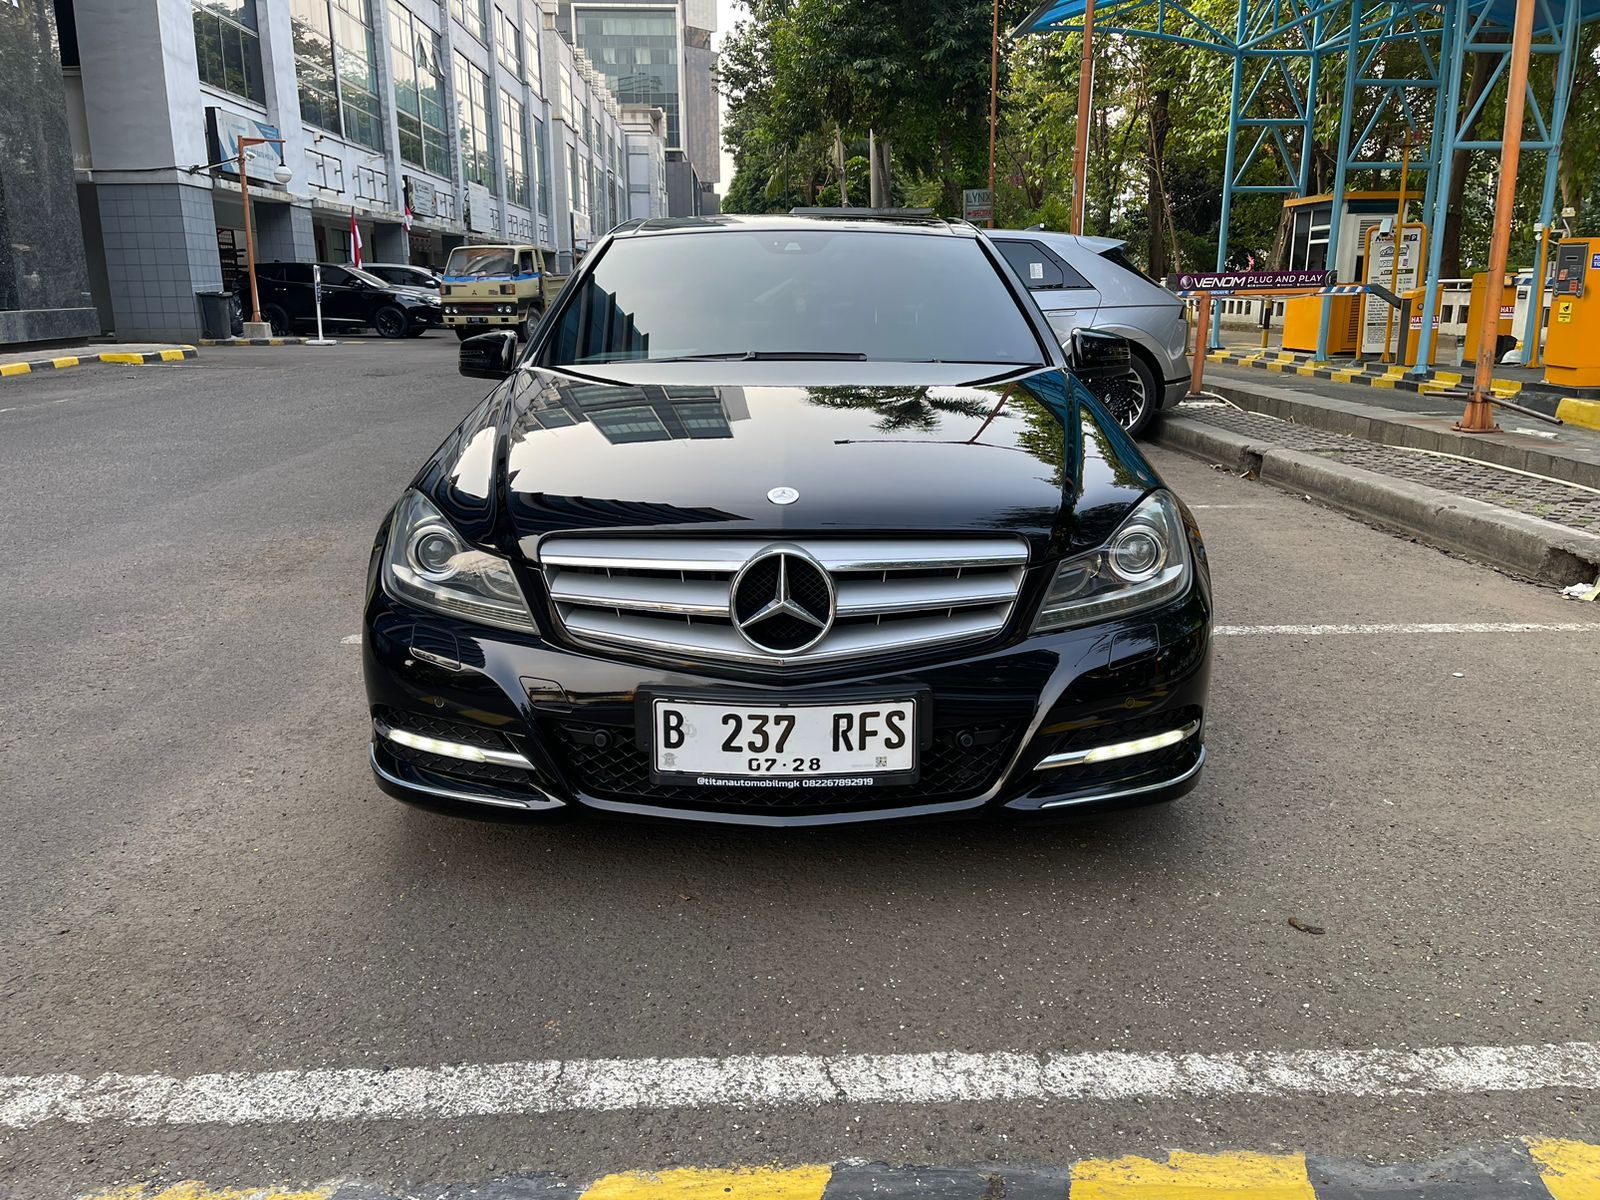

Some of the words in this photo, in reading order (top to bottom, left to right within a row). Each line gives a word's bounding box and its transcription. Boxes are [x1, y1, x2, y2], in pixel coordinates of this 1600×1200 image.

[966, 192, 991, 202] LYNX
[1193, 276, 1247, 288] VENOM
[1247, 275, 1273, 284] PLUG
[1275, 275, 1296, 283] AND
[1298, 274, 1323, 282] PLAY
[663, 709, 685, 750] B
[721, 713, 796, 754] 237
[831, 709, 906, 752] RFS
[697, 777, 800, 789] @titanautomobilmgk
[802, 777, 874, 788] 082267892919
